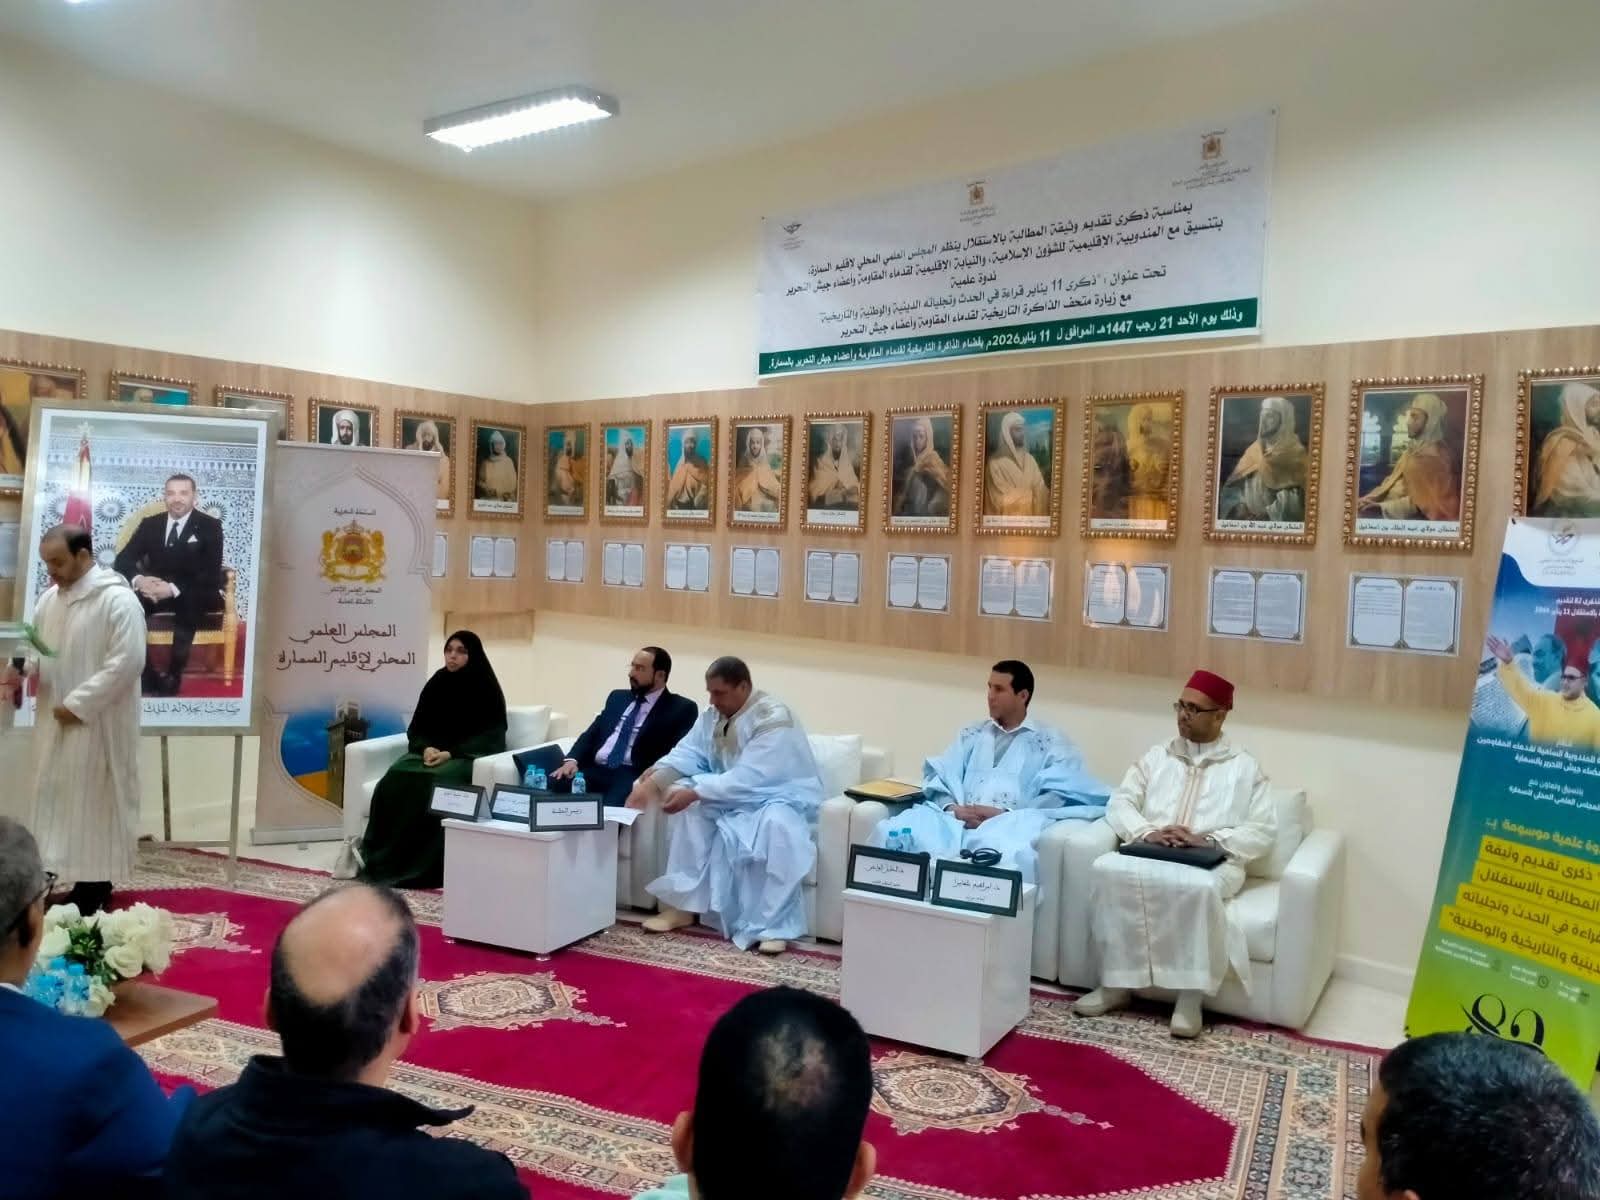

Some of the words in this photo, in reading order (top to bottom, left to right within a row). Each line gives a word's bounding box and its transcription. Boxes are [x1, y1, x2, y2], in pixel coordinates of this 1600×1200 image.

[1115, 211, 1149, 227] ذكرى
[1151, 201, 1193, 220] بمناسبة
[1050, 222, 1078, 236] وثيقة
[1082, 213, 1112, 231] تقديم
[1183, 216, 1223, 236] بتنسيق
[1010, 225, 1047, 243] المطالبة
[1116, 226, 1164, 246] المندوبية
[1167, 226, 1180, 240] مع
[889, 266, 913, 280] لقدماء
[977, 271, 997, 286] ندوة
[1109, 269, 1139, 287] عنوان
[1142, 264, 1168, 280] تحت
[950, 275, 976, 289] علمية
[1026, 281, 1049, 298] يناير
[1052, 278, 1063, 291] 11
[986, 288, 1000, 305] في
[1063, 295, 1092, 310] متحف
[1094, 291, 1118, 308] زيارة
[1118, 293, 1132, 307] مع
[952, 310, 979, 323] لقدماء
[1159, 315, 1174, 330] 21
[1177, 312, 1199, 326] الأحد
[1201, 313, 1217, 329] يوم
[1220, 307, 1243, 322] وذلك
[840, 324, 867, 339] التحرير
[868, 322, 889, 336] جيش
[1135, 320, 1157, 333] رجب
[1039, 329, 1051, 343] 11
[288, 622, 347, 645] العلمي
[331, 623, 396, 645] المجلس
[275, 649, 327, 671] السمارة
[356, 651, 416, 673] المحلي
[1502, 818, 1550, 841] موسومة
[1552, 831, 1584, 849] علمية
[1521, 853, 1561, 872] تقديم
[1479, 867, 1543, 896] بالاستقلال
[1462, 889, 1510, 916] وتجلياته
[1547, 888, 1600, 913] المطالبة
[1511, 904, 1550, 927] الحدث
[1551, 919, 1569, 936] في
[1510, 934, 1568, 965] والتاريخية
